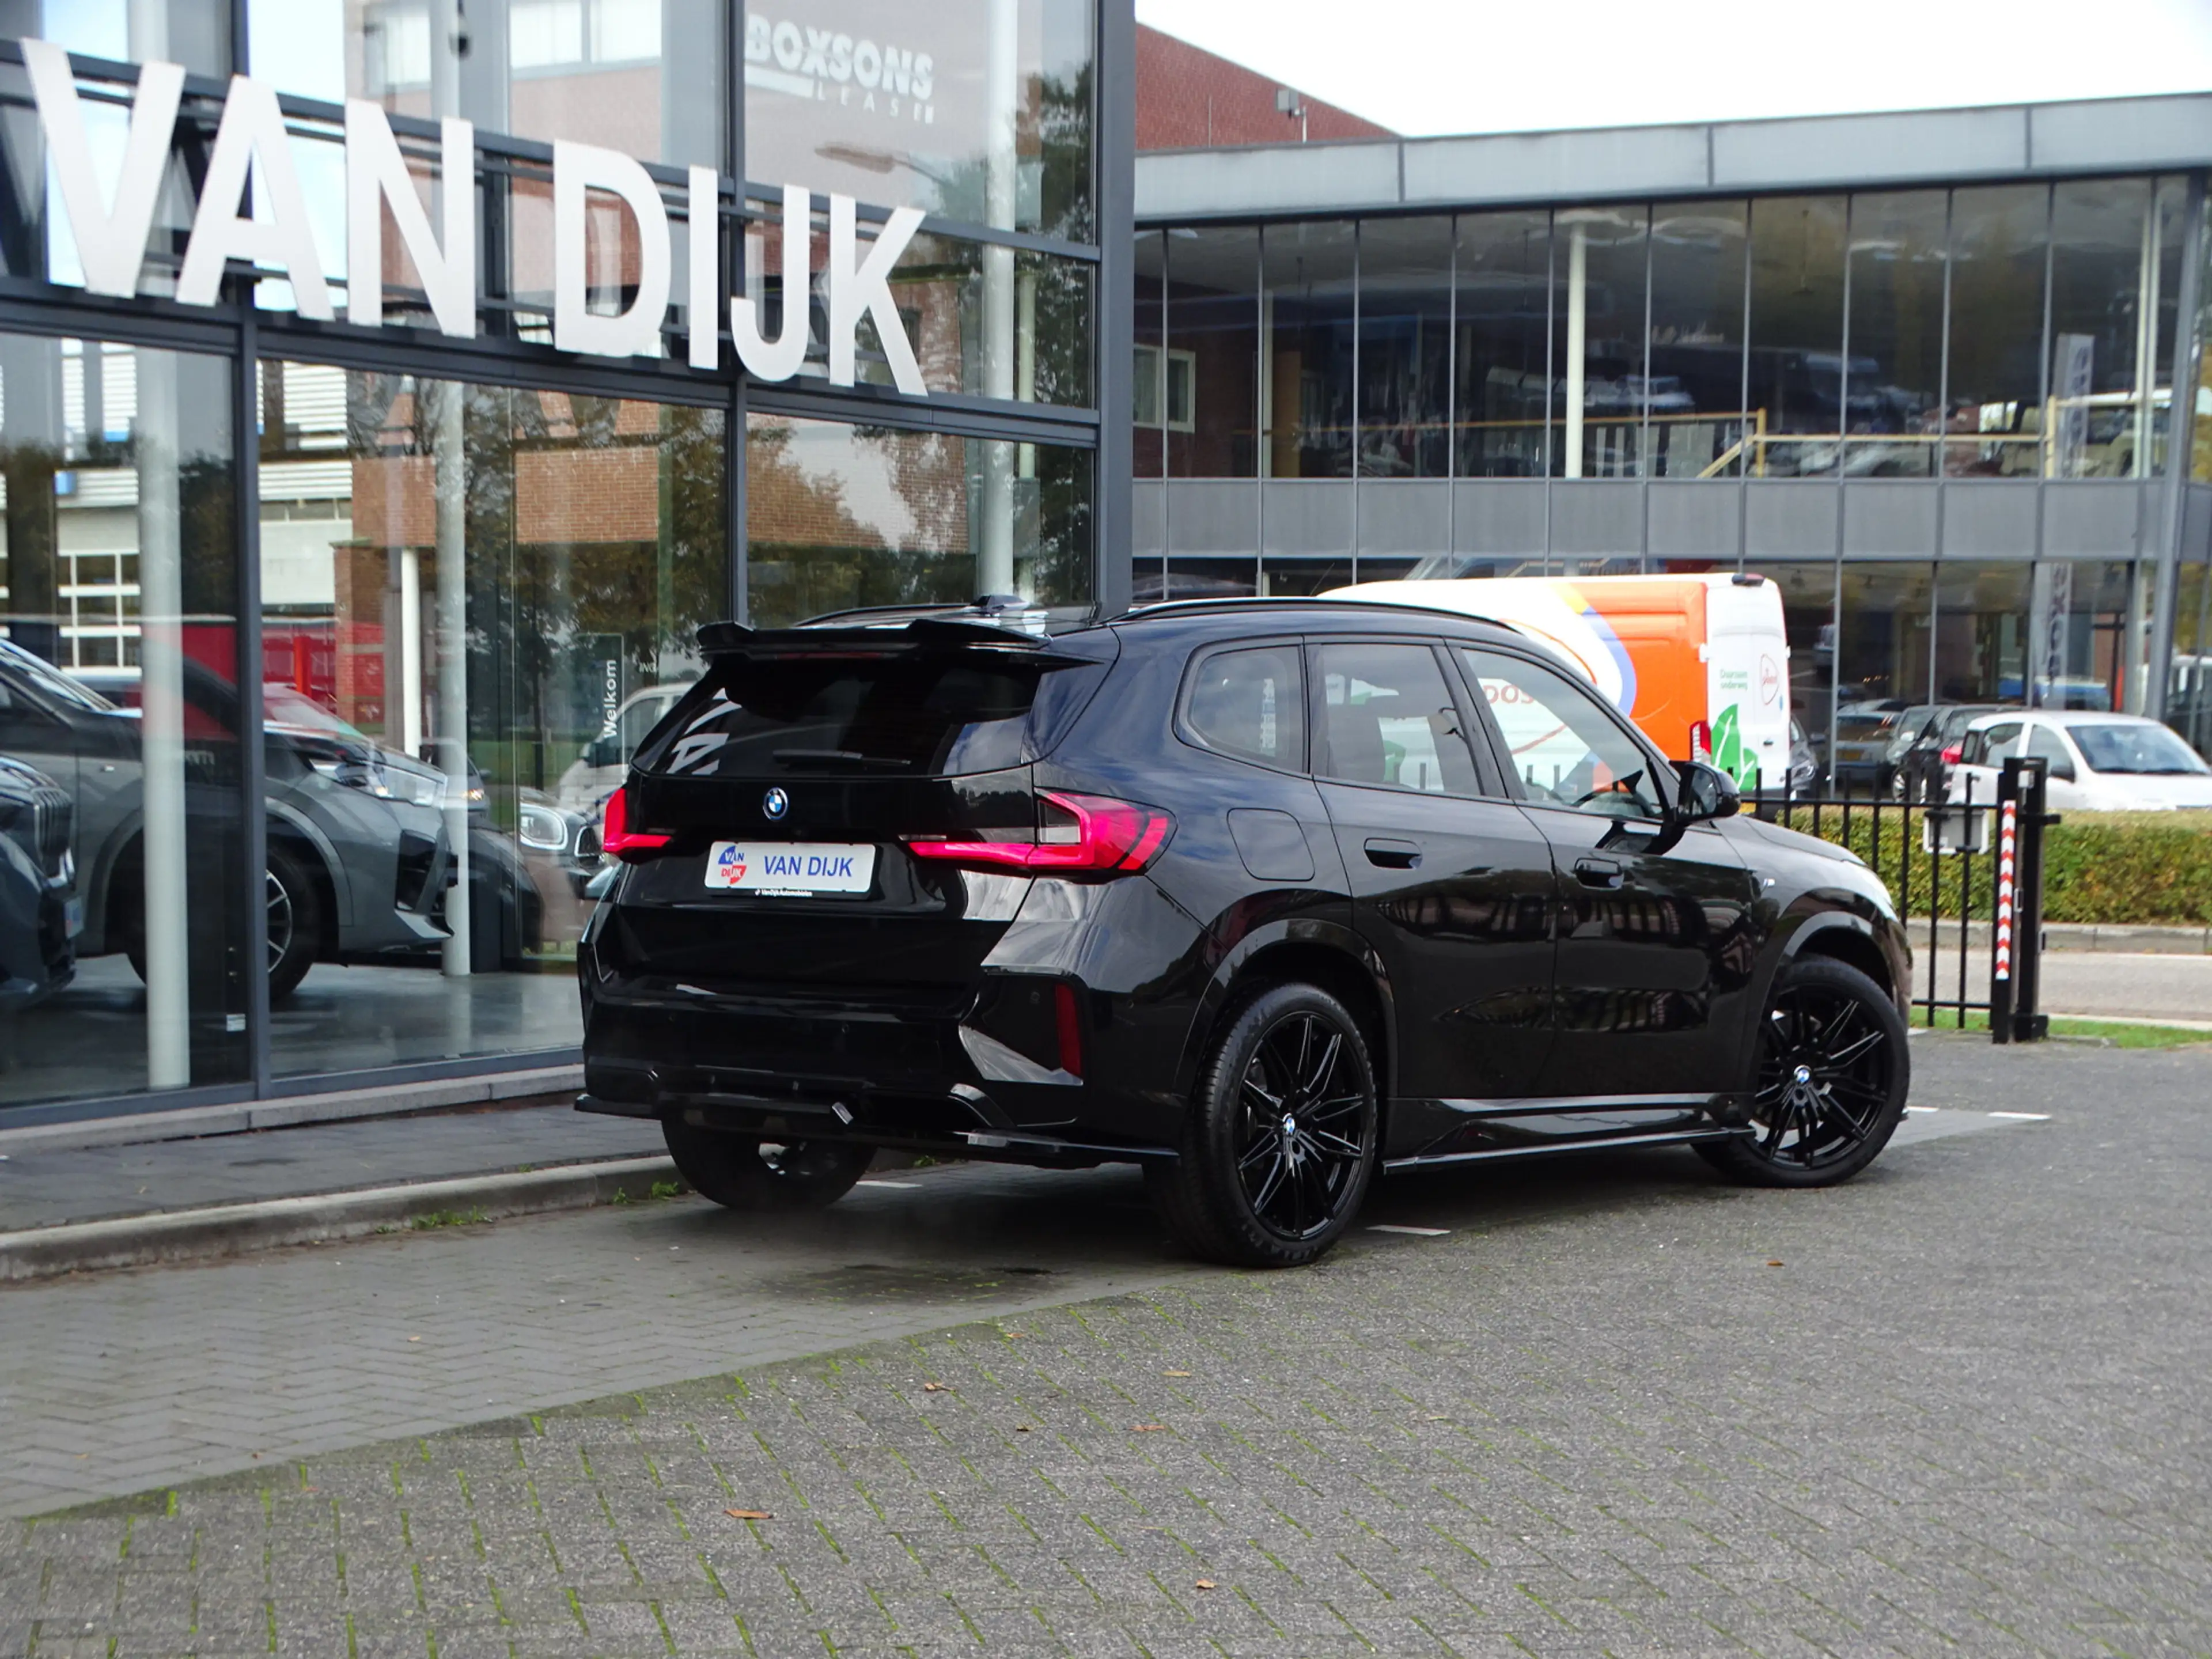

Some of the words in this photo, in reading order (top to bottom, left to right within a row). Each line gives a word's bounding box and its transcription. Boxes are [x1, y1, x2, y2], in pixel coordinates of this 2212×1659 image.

[745, 14, 933, 100] BOXSONS
[20, 37, 476, 339] VAN
[554, 139, 929, 397] DIJK
[603, 660, 618, 738] Welkom
[725, 851, 745, 862] VAN
[764, 855, 802, 876] VAN
[808, 857, 854, 877] DIJK
